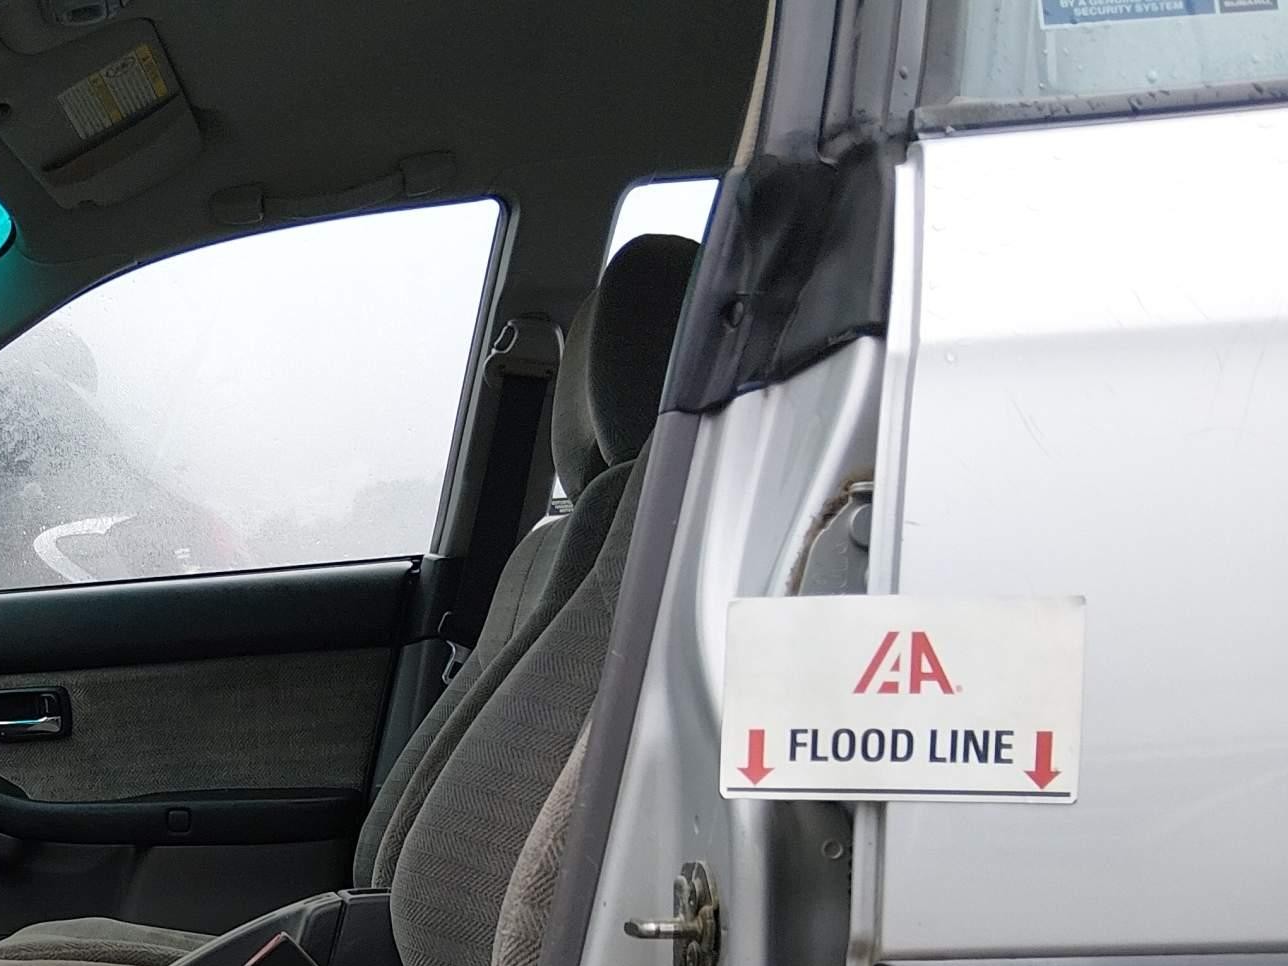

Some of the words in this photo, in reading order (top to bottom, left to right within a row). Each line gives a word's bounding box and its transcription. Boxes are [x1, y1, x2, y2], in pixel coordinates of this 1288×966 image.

[1074, 4, 1132, 16] SECURITY
[1135, 1, 1184, 13] SYSTEM
[788, 728, 915, 762] FLOOD
[928, 729, 1015, 764] LINE
